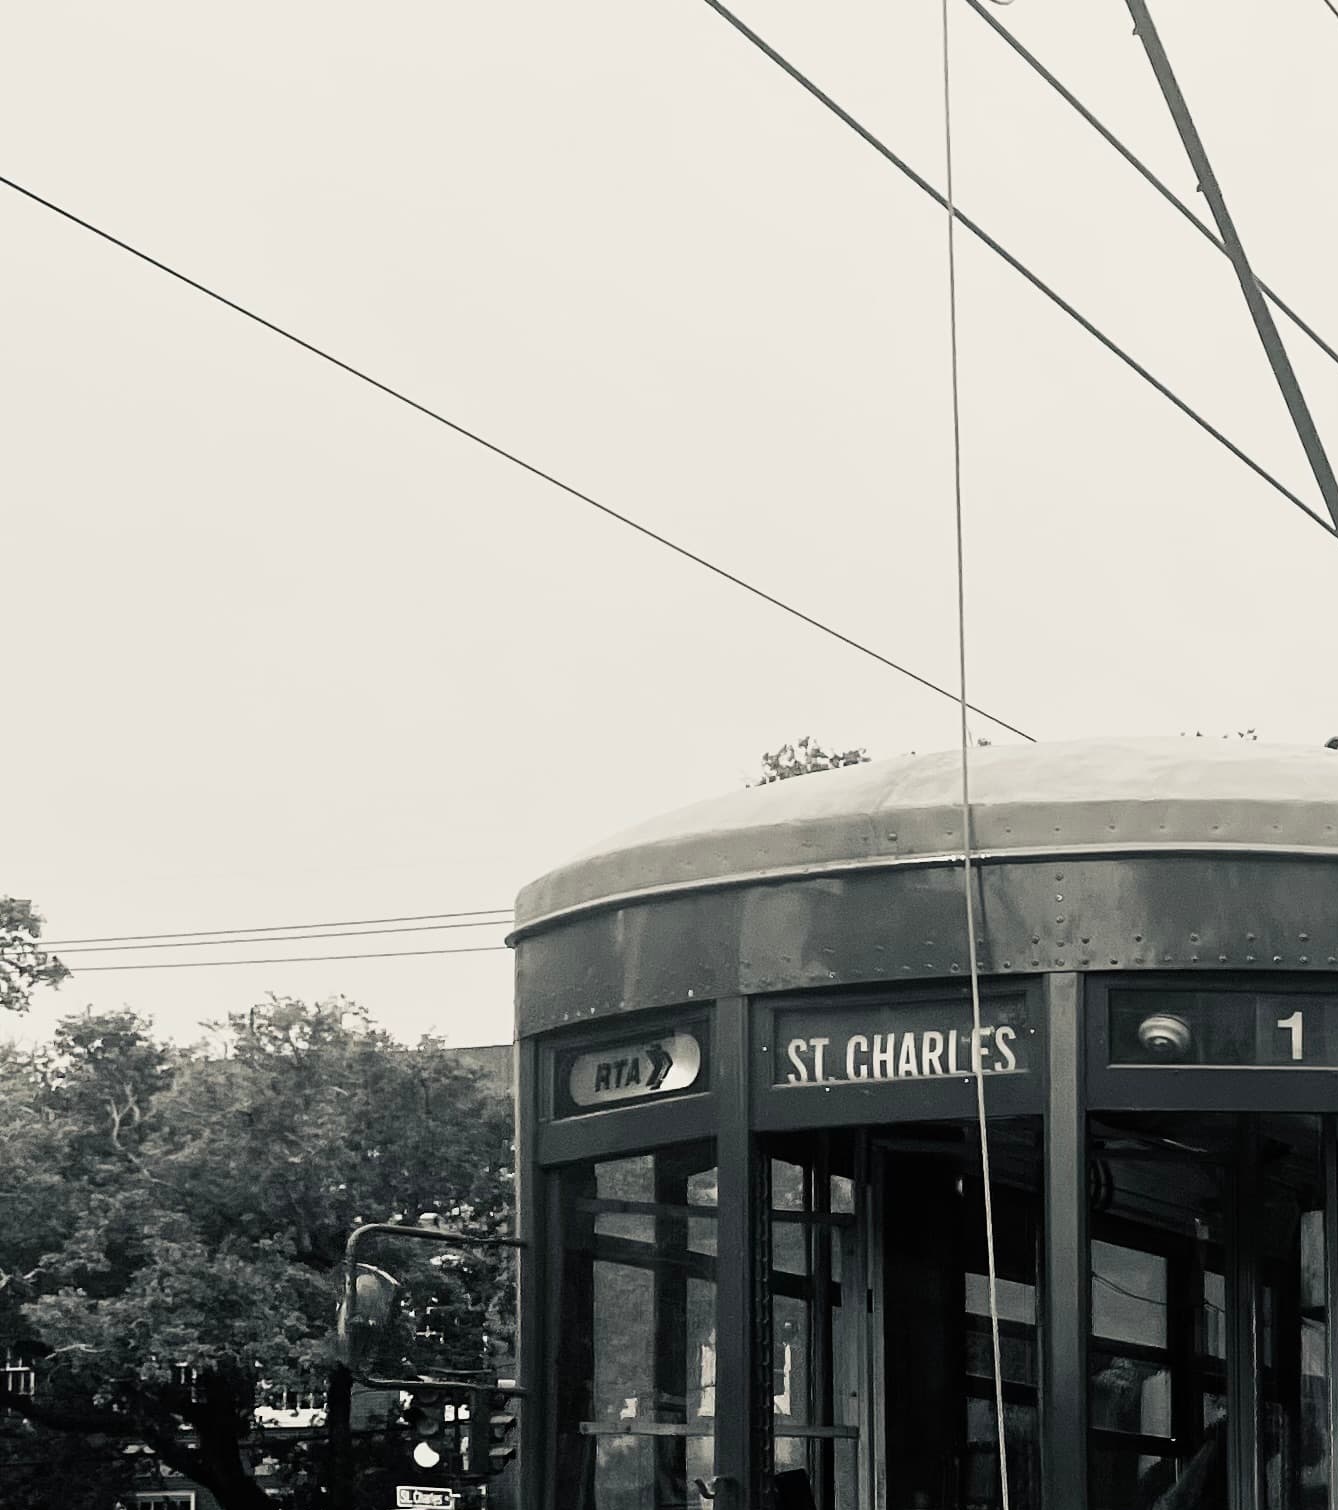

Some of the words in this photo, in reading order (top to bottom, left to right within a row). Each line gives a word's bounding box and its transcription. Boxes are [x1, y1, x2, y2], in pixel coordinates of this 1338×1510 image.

[845, 1025, 1017, 1081] CHARLES
[593, 1062, 641, 1092] RTA
[413, 1490, 442, 1505] Charles
